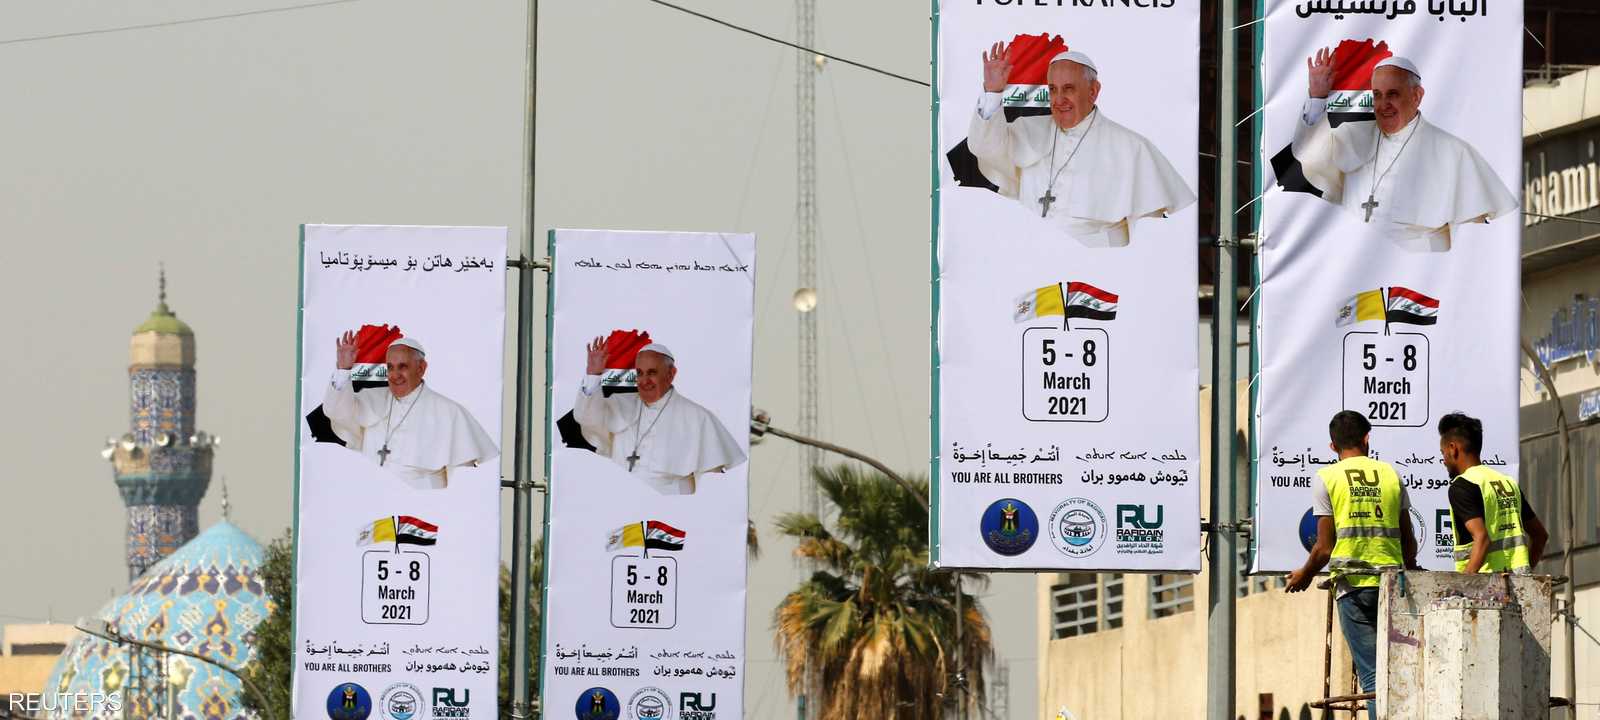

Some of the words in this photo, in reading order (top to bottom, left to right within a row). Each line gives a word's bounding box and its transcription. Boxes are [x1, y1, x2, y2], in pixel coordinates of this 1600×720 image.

[1524, 140, 1600, 227] Islami
[1043, 339, 1056, 366] 5
[1083, 340, 1096, 367] 8
[1363, 344, 1376, 370] 5
[1403, 344, 1417, 371] 8
[1044, 372, 1090, 390] March
[1364, 376, 1410, 394] March
[1048, 396, 1086, 415] 2021
[1369, 401, 1406, 420] 2021
[951, 472, 970, 483] YOU
[974, 472, 992, 484] ARE
[994, 473, 1010, 484] ALL
[1013, 473, 1063, 484] BROTHERS
[1271, 476, 1290, 488] YOU
[1293, 477, 1312, 488] ARE
[1344, 469, 1380, 486] RU
[1117, 504, 1164, 529] RU
[378, 560, 388, 580] 5
[409, 561, 420, 581] 8
[627, 565, 637, 586] 5
[657, 566, 667, 586] 8
[378, 585, 415, 600] March
[627, 590, 663, 604] March
[382, 605, 411, 619] 2021
[630, 609, 659, 624] 2021
[304, 662, 320, 671] YOU
[321, 663, 336, 672] ARE
[338, 663, 352, 672] ALL
[353, 663, 392, 673] BROTHERS
[554, 667, 569, 676] YOU
[571, 667, 585, 676] ARE
[586, 667, 600, 676] ALL
[602, 667, 640, 677] BROTHERS
[433, 688, 469, 707] RU
[680, 692, 716, 711] RU
